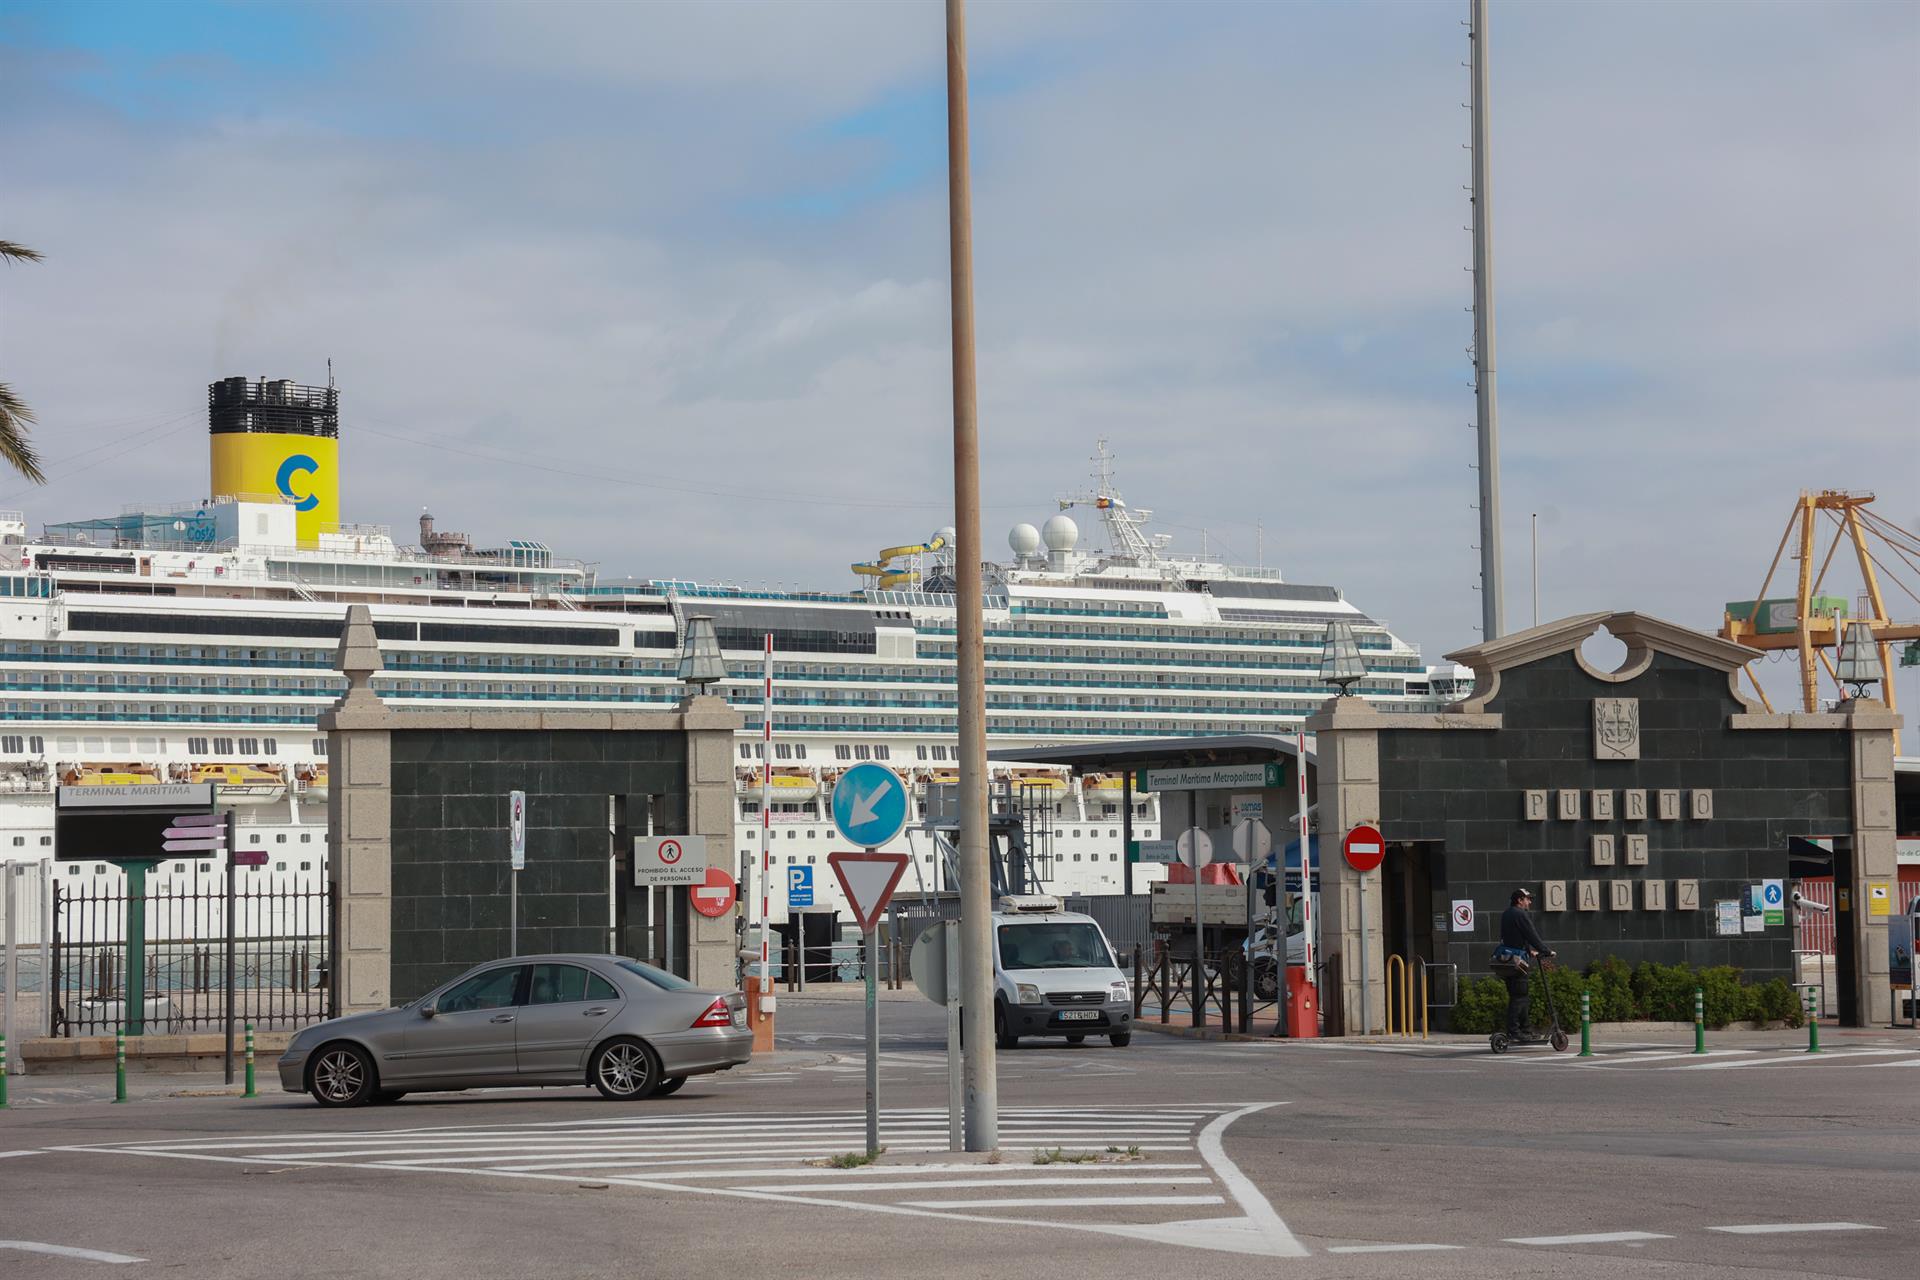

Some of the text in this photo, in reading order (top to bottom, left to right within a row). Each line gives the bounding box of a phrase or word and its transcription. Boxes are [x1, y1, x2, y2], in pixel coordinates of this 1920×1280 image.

[187, 527, 215, 542] Costa
[1150, 774, 1178, 786] Terminal
[1213, 771, 1262, 785] Metropolitana
[68, 787, 128, 797] TERMINAL
[1530, 793, 1710, 816] PUERTO
[1598, 838, 1645, 861] DE
[789, 869, 805, 891] P
[1550, 883, 1696, 907] CADIZ
